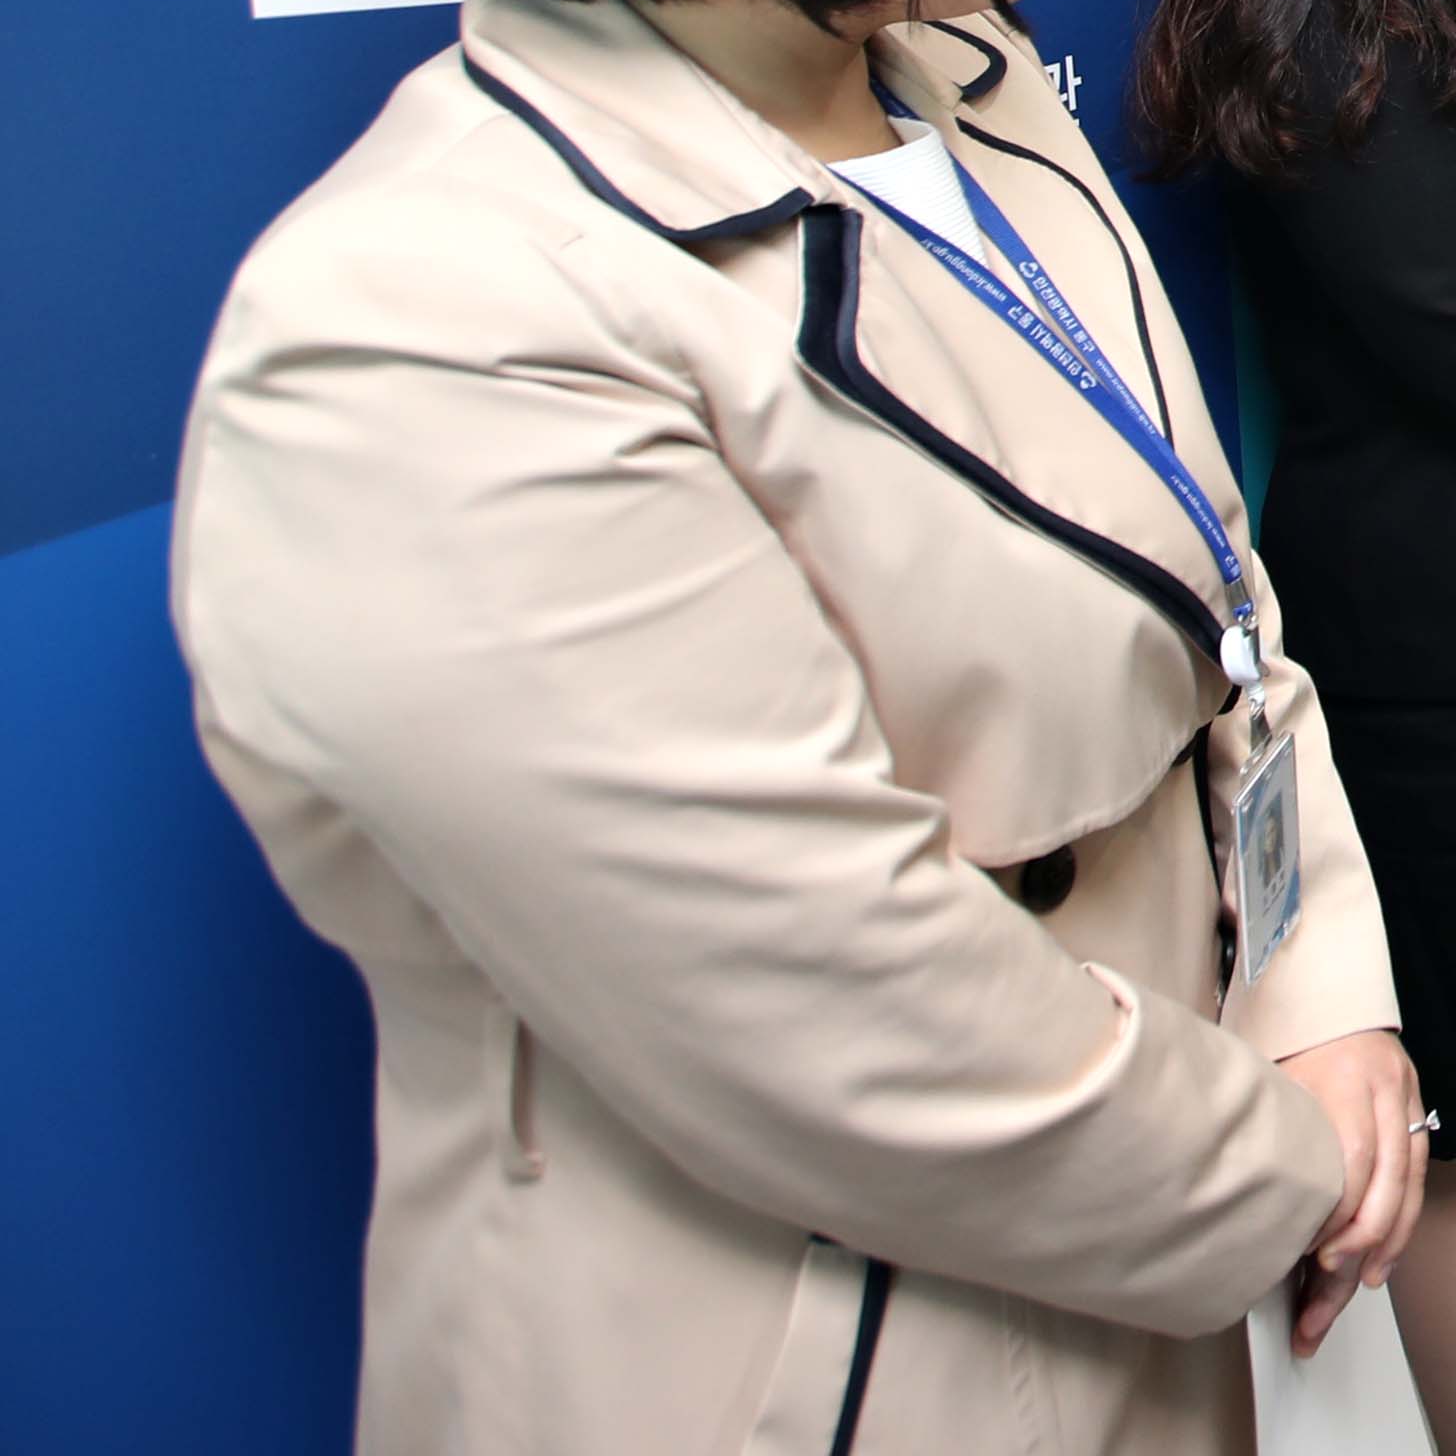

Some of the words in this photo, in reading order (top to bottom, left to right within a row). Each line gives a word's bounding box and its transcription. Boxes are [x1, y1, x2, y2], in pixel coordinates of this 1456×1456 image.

[1007, 303, 1032, 332] 동구
[1032, 271, 1077, 329] 인천광역시
[1073, 326, 1095, 354] 동구
[1031, 323, 1081, 376] 인천광역시
